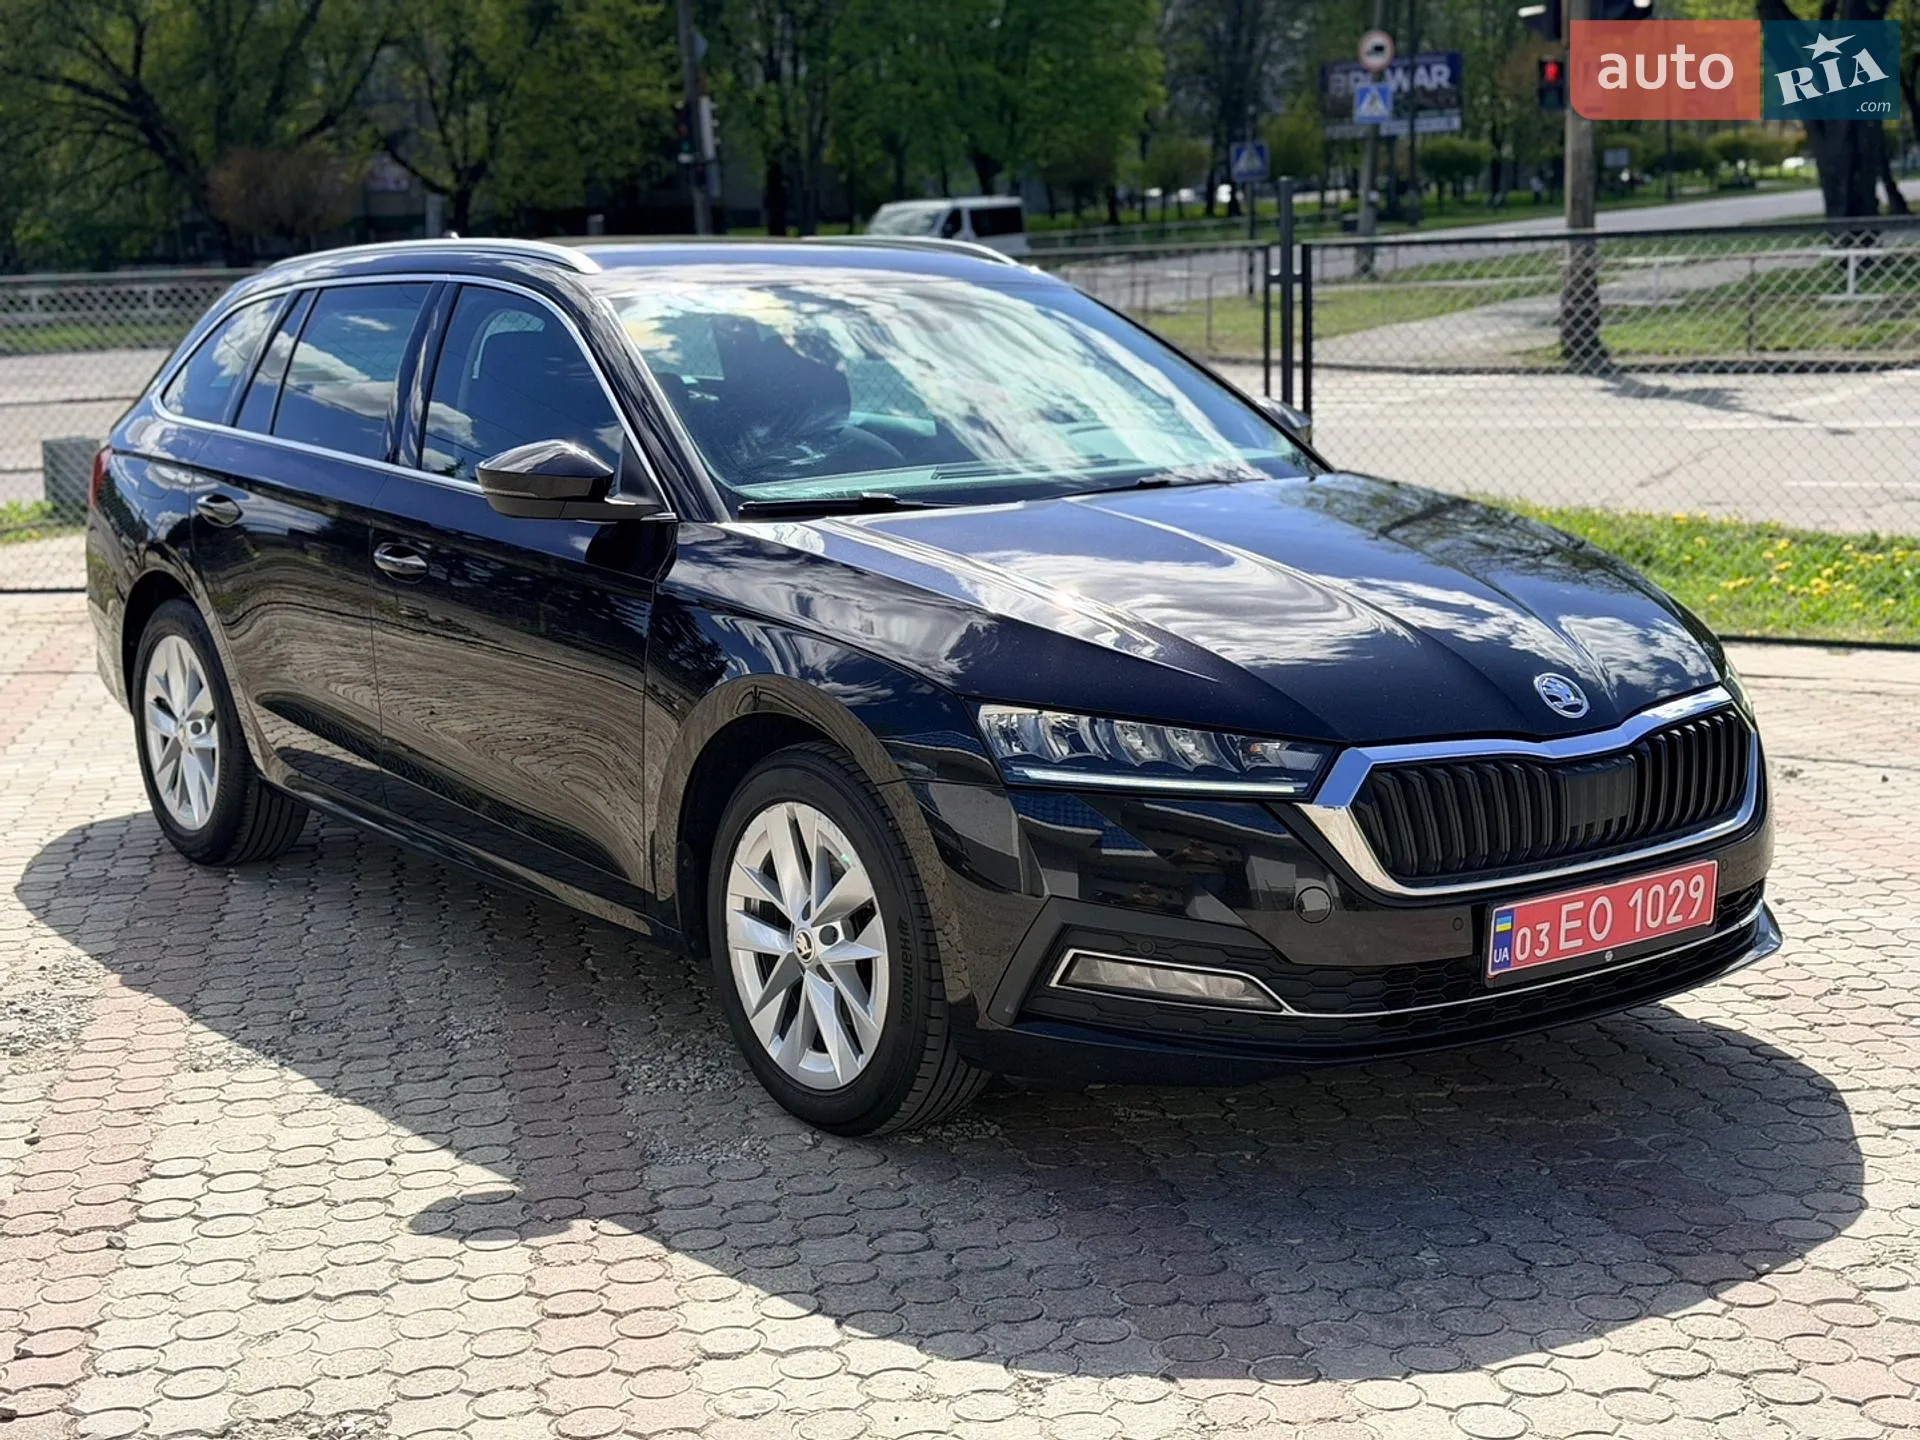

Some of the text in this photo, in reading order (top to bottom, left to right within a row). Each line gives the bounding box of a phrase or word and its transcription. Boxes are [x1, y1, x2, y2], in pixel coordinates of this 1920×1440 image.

[1328, 63, 1451, 97] BRWAR
[1515, 874, 1705, 961] 03 EO 1029
[1493, 948, 1510, 964] UA
